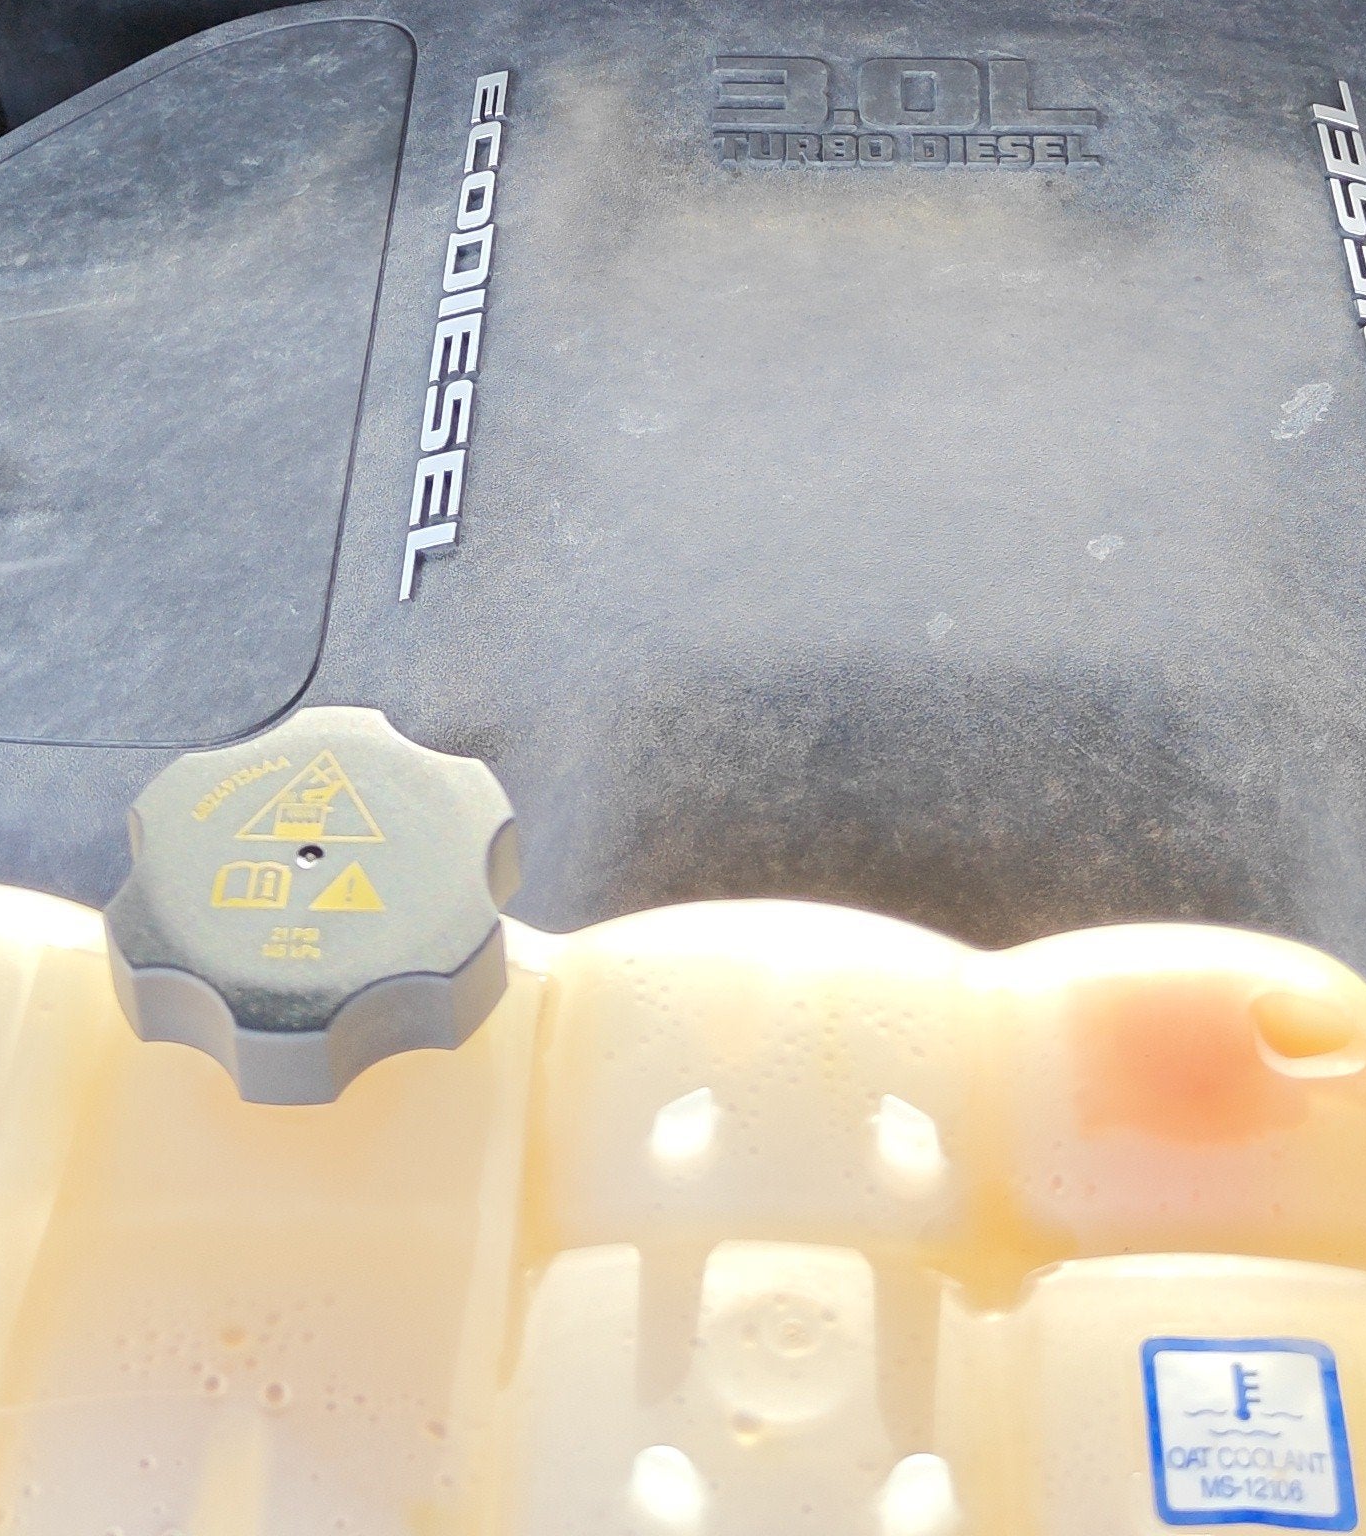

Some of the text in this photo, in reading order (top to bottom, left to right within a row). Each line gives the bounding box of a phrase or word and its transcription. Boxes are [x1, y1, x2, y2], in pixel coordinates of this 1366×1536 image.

[711, 54, 1101, 132] 3.0L
[712, 131, 1103, 166] TURBO DIESEL
[398, 69, 510, 602] ECODIESEL
[1167, 1446, 1327, 1474] OAT COOLANT
